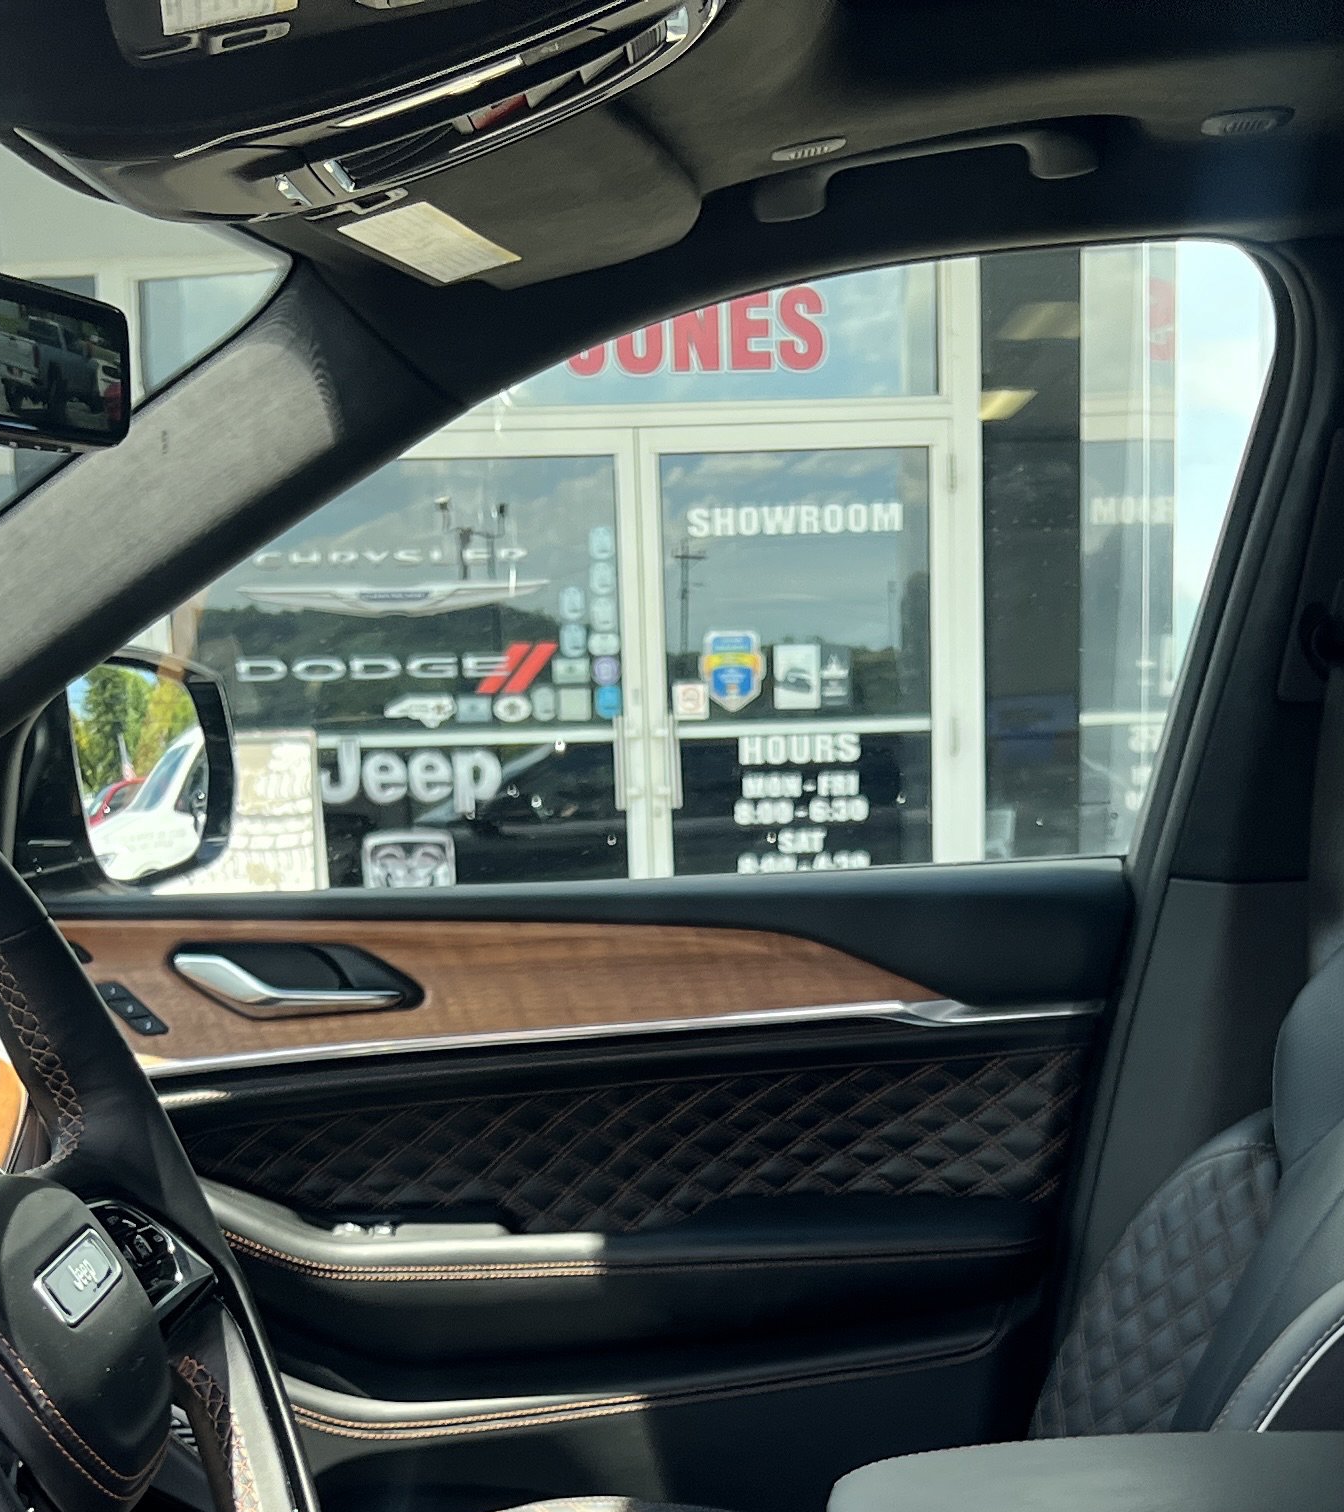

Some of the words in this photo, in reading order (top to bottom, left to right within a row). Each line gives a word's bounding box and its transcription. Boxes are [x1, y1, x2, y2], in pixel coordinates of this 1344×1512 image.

[564, 283, 827, 377] ONES
[687, 502, 904, 538] SHOWROOM
[235, 654, 511, 682] DODGE
[738, 734, 862, 765] HOURS
[320, 739, 502, 819] Jeep
[777, 829, 827, 854] SAT
[68, 1258, 98, 1292] Jeep
